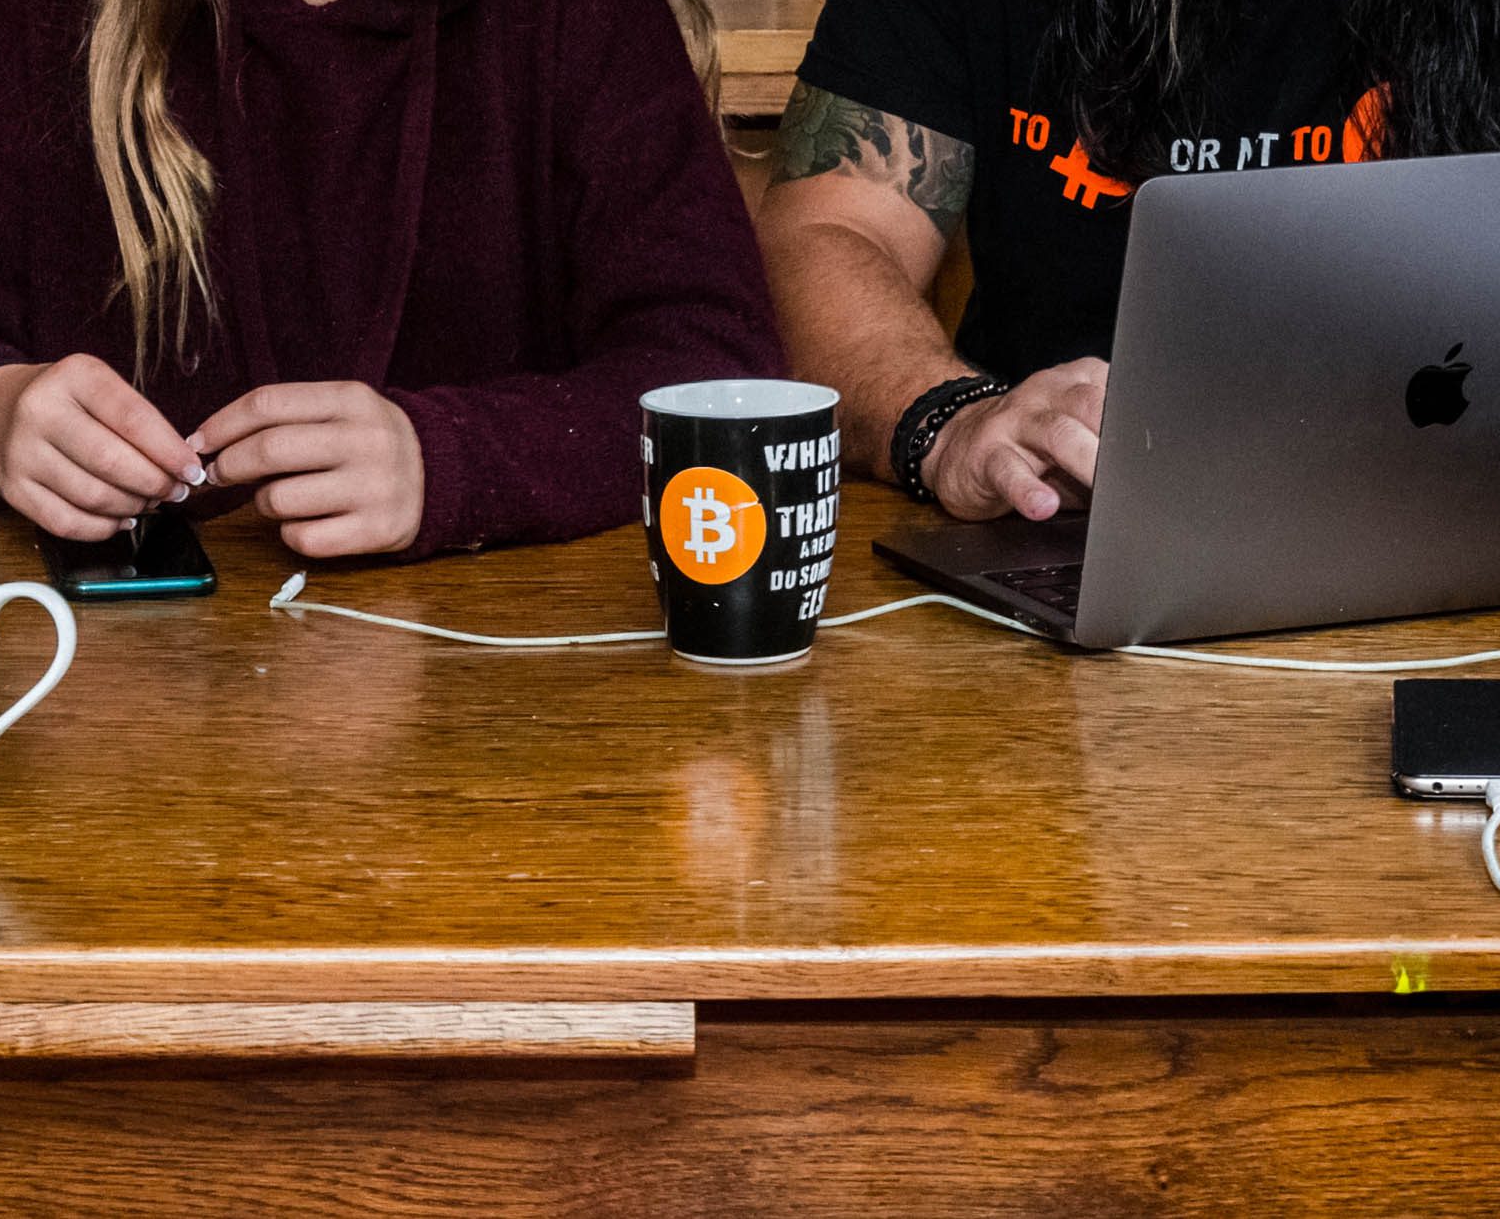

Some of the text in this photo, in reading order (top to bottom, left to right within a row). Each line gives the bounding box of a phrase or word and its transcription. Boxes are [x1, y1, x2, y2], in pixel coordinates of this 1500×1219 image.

[1010, 107, 1051, 151] TO
[1170, 138, 1221, 172] OR
[1291, 126, 1332, 162] TO
[770, 569, 797, 591] DO
